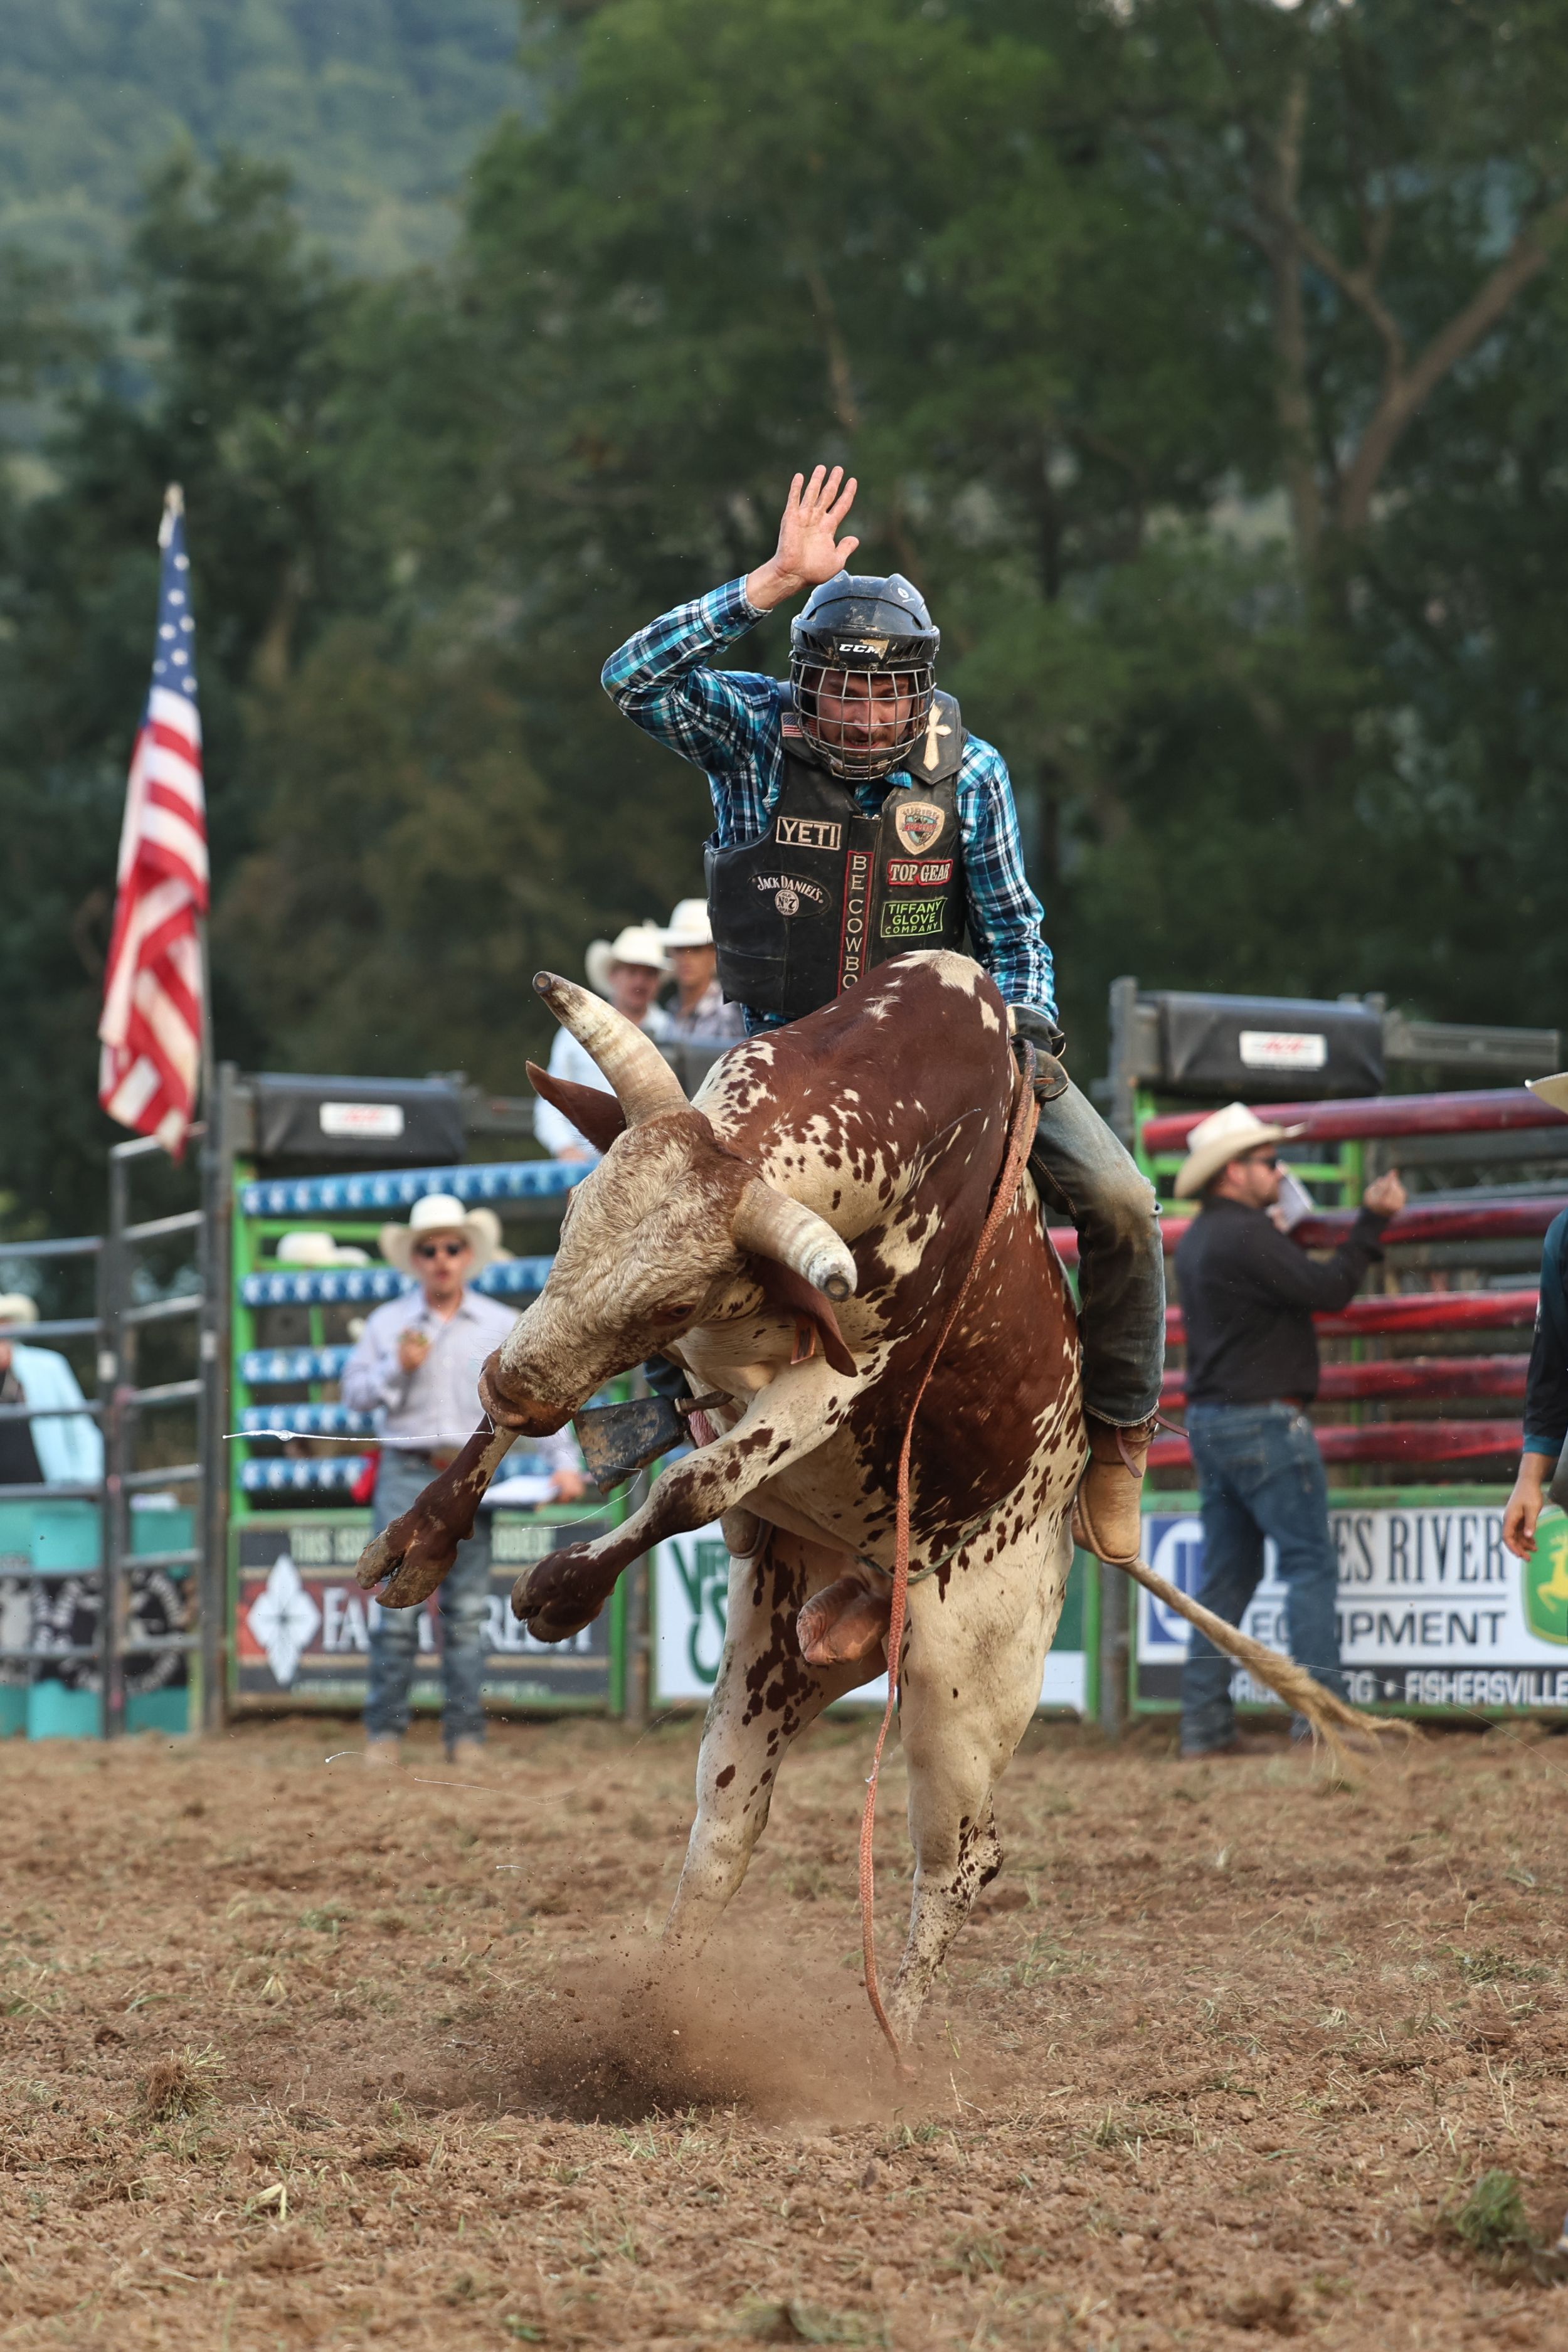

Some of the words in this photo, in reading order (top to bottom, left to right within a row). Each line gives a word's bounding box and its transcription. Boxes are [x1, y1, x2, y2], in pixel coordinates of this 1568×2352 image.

[839, 644, 879, 654] CCM
[781, 818, 836, 847] YETI
[851, 855, 867, 890] BE
[891, 864, 918, 882] TOP
[920, 863, 950, 882] GEAR
[757, 876, 780, 891] JACK
[780, 875, 823, 901] DANIEL'S
[888, 901, 942, 914] TIFFANY
[893, 912, 936, 924] GLOVE
[885, 922, 938, 935] COMPANY
[842, 899, 863, 989] COWBO
[1387, 1513, 1507, 1582] RIVER
[1252, 1609, 1507, 1646] EIPMENT
[1405, 1670, 1568, 1706] FISHERSVILLE
